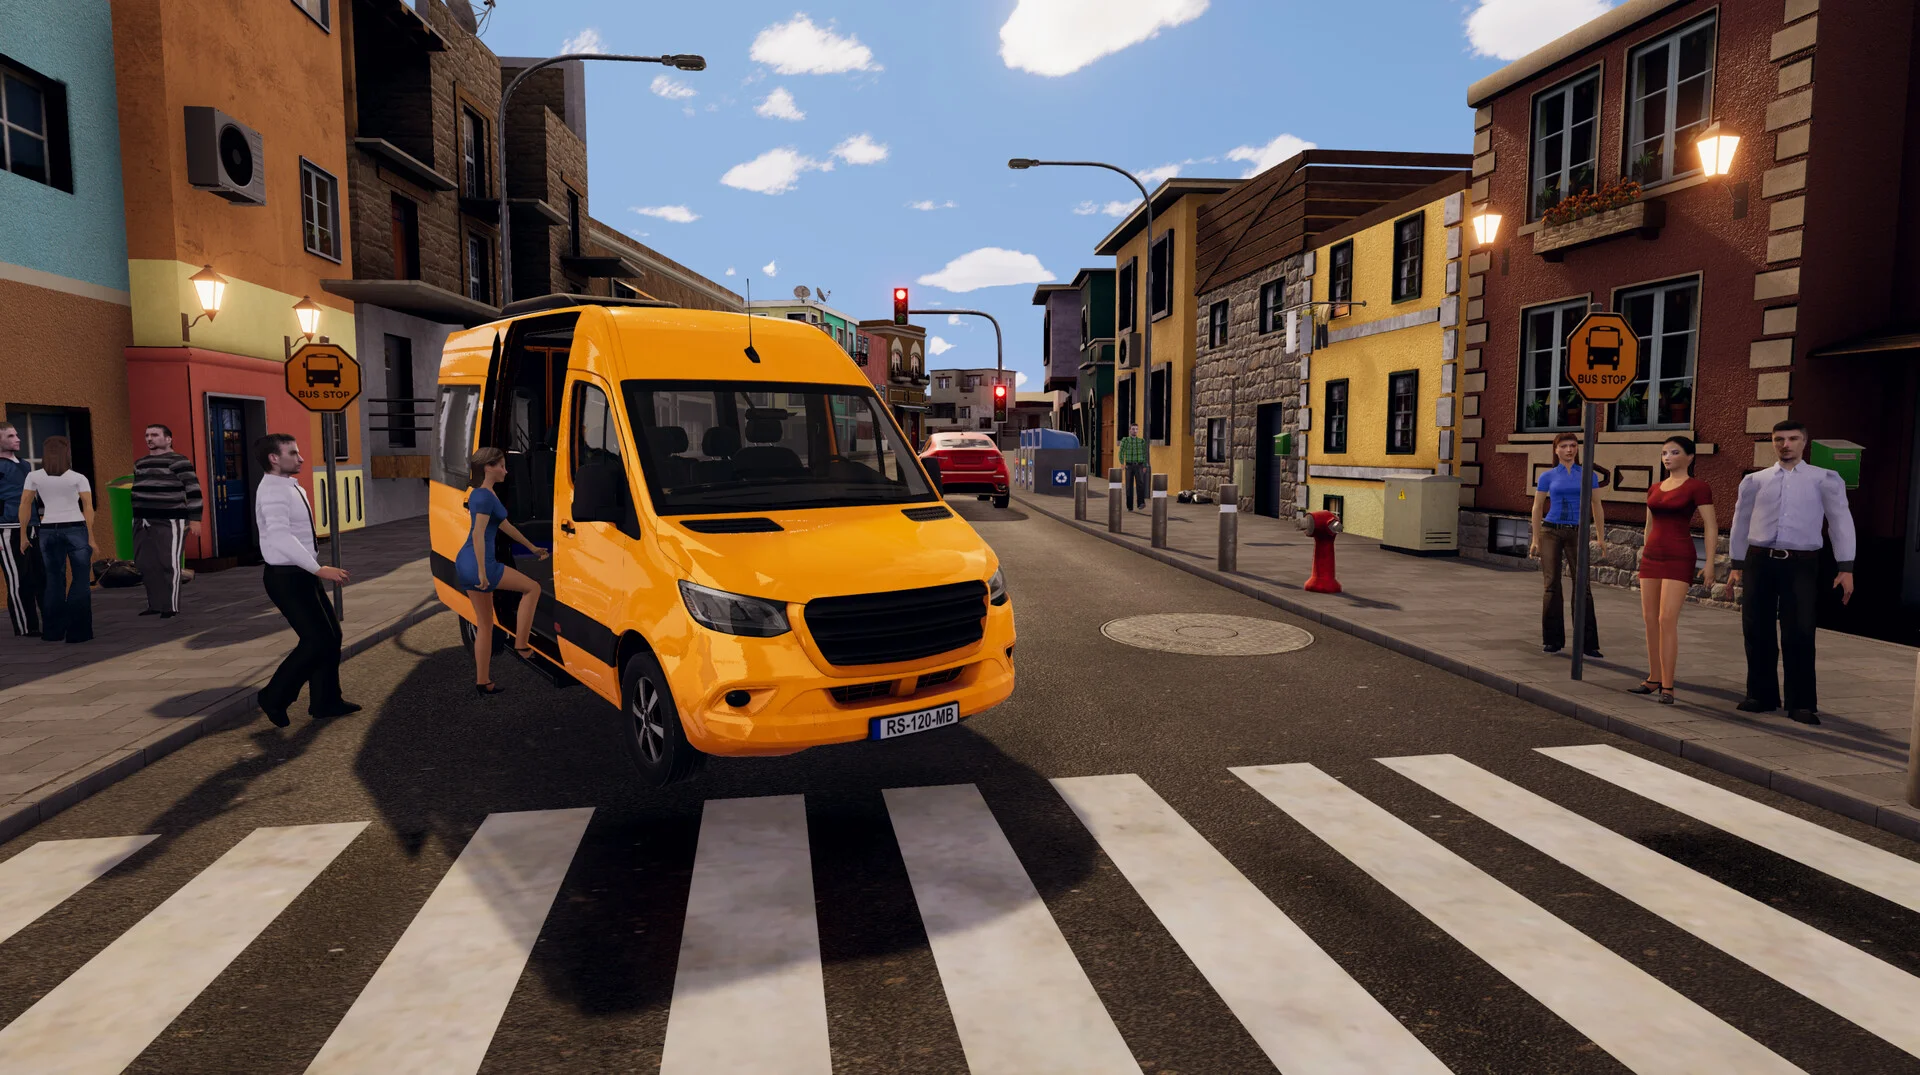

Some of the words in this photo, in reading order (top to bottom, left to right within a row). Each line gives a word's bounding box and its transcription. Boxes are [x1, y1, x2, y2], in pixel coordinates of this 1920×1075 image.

[1578, 374, 1598, 384] BUS
[1601, 375, 1627, 384] STOP
[298, 390, 319, 398] BUS
[887, 707, 954, 736] RS-120-MB
